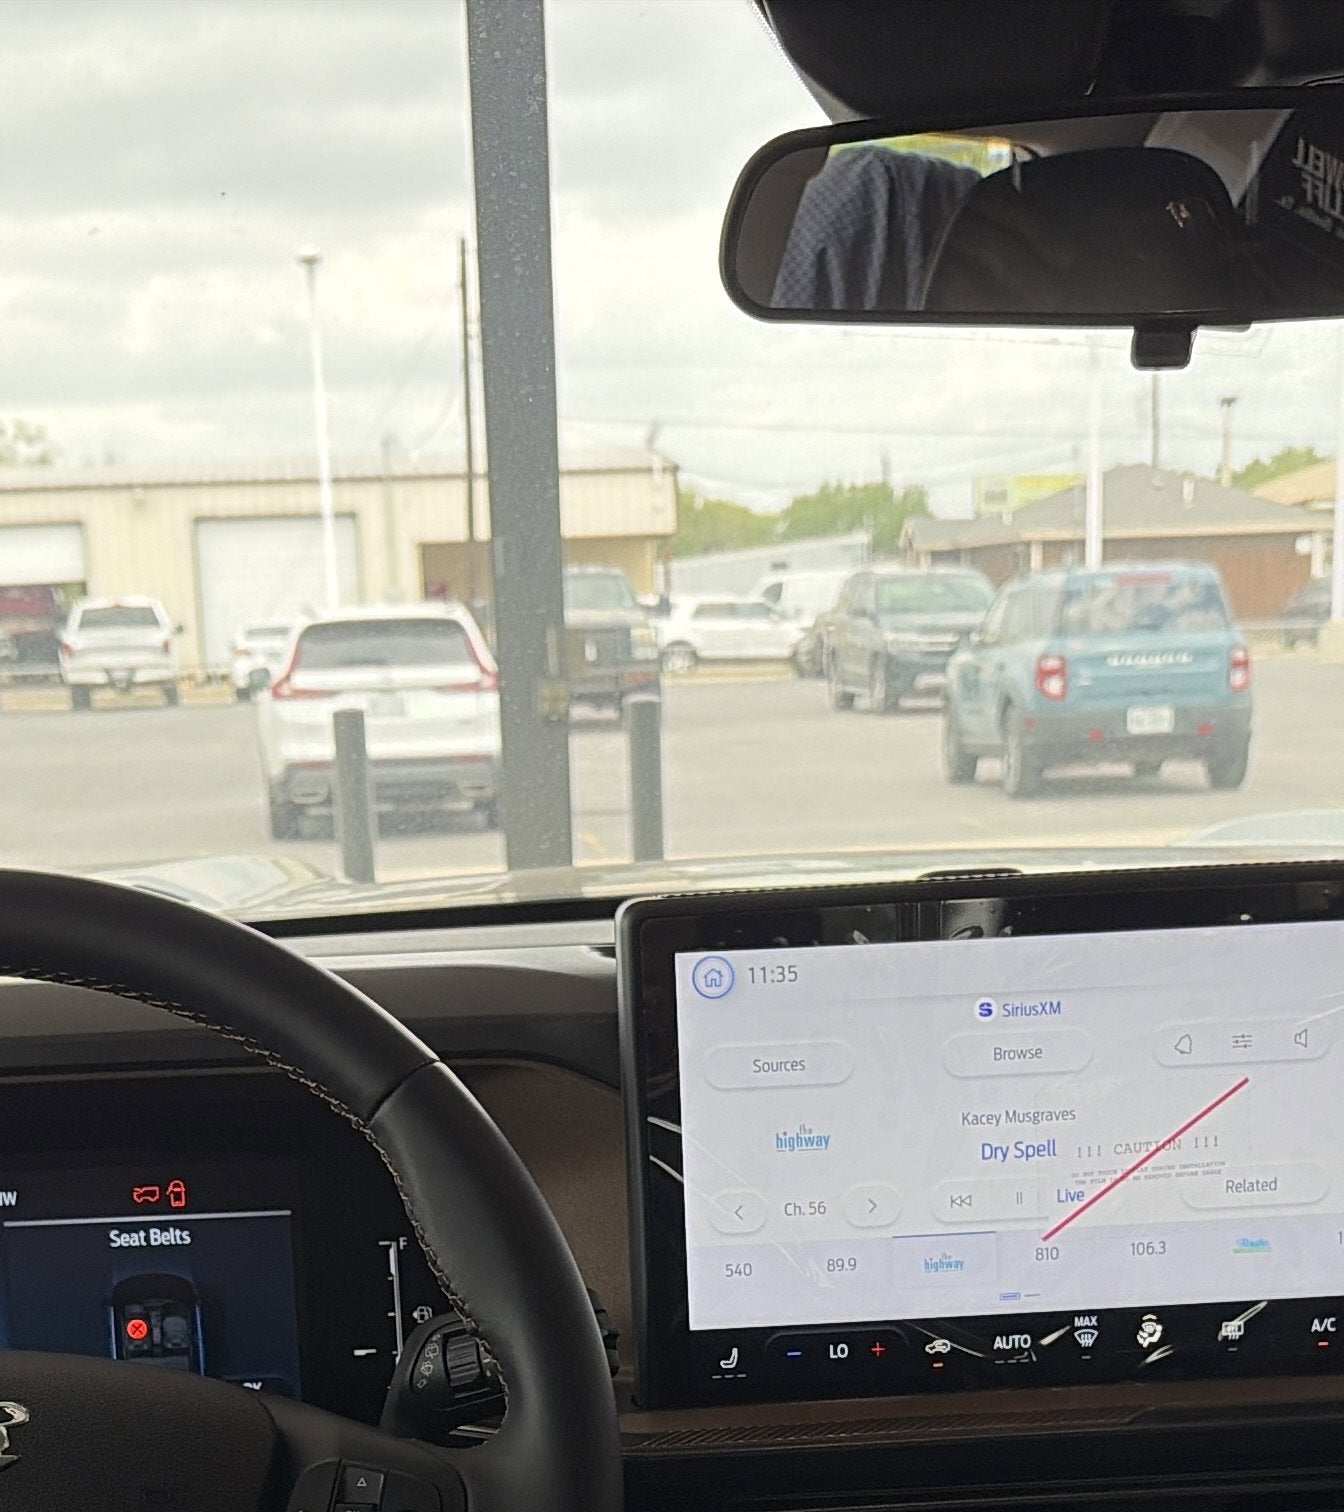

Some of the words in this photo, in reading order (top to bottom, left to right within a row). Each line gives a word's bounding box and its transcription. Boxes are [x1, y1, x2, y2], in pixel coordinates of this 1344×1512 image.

[747, 965, 798, 985] 11:35
[1002, 1001, 1061, 1018] SiriusXM
[993, 1046, 1043, 1061] Browse
[752, 1058, 806, 1074] Sources
[961, 1110, 1002, 1127] Kacey
[1005, 1107, 1076, 1127] Musgraves
[776, 1131, 830, 1152] highway
[981, 1142, 1008, 1163] Dry
[1014, 1139, 1057, 1161] Spell
[1225, 1177, 1278, 1193] Related
[1056, 1188, 1085, 1203] Live
[784, 1202, 805, 1217] Ch.
[808, 1201, 827, 1216] 56
[109, 1230, 147, 1247] Seat
[150, 1227, 191, 1246] Belts
[398, 1237, 408, 1250] F
[1035, 1247, 1059, 1261] 810
[1131, 1241, 1167, 1256] 106.3
[725, 1262, 752, 1278] 540
[827, 1257, 857, 1272] 89.9
[924, 1257, 964, 1271] highway
[1074, 1315, 1097, 1327] MAX
[1310, 1317, 1337, 1333] A/C
[993, 1334, 1030, 1350] AUTO
[829, 1343, 848, 1359] LO
